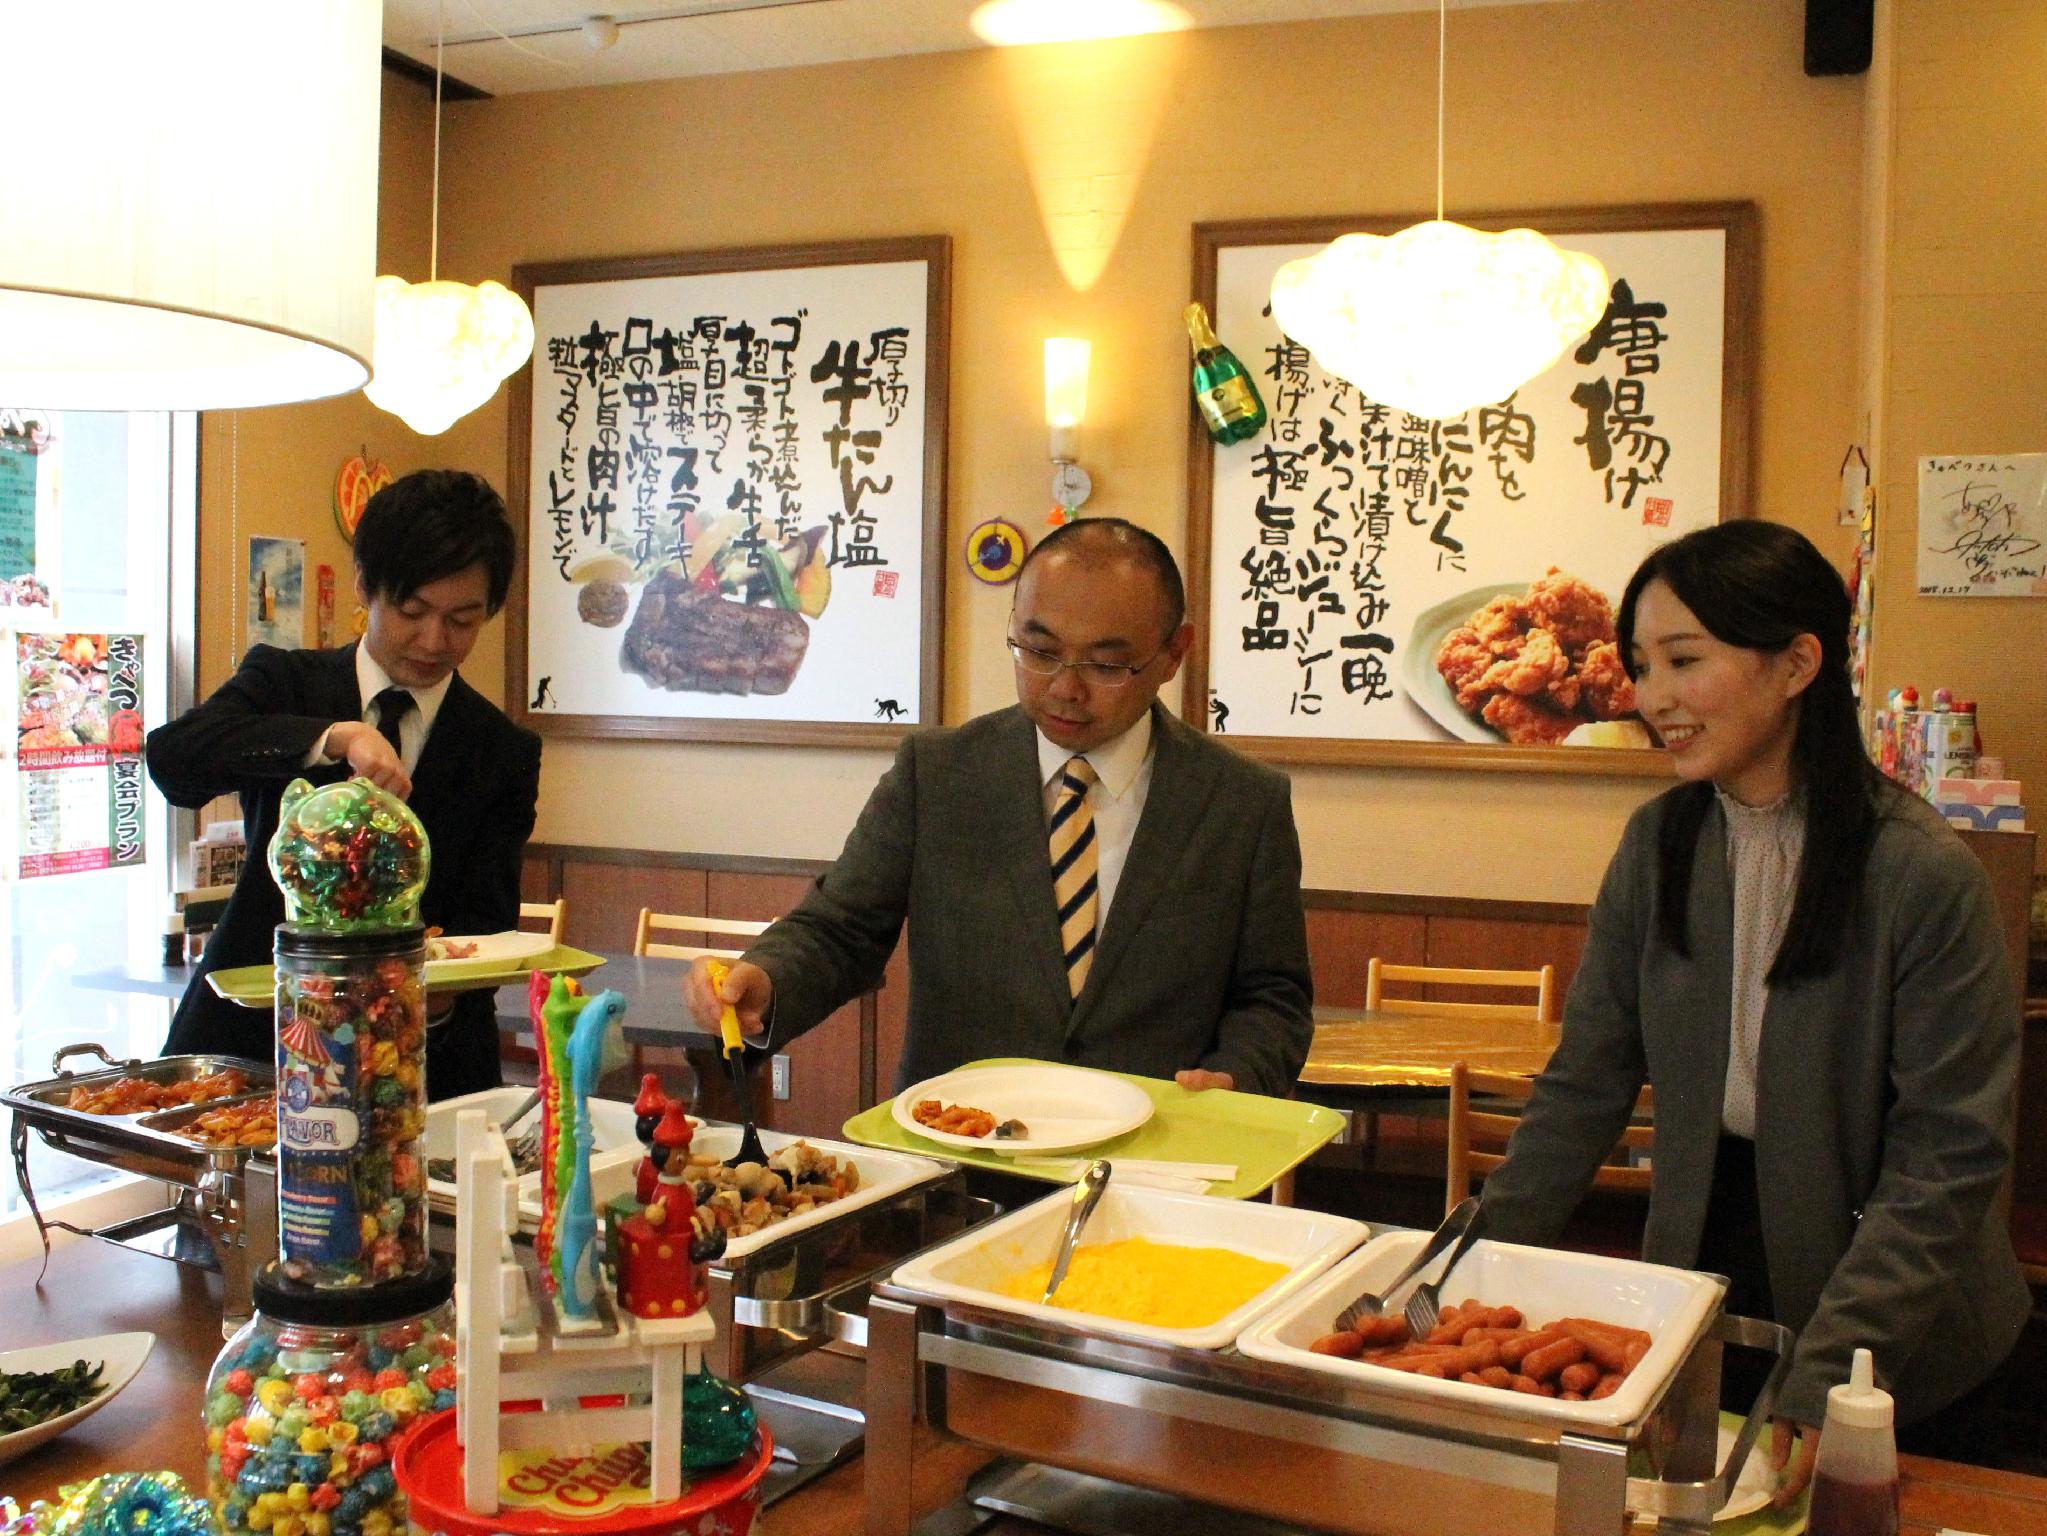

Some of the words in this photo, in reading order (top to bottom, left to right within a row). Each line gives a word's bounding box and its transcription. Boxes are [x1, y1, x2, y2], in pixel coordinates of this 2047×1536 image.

[622, 317, 662, 571] 口の中で溶けだす
[688, 316, 731, 473] 厚目に切って
[769, 308, 808, 540] ゴトゴト煮込んだ
[811, 340, 892, 568] 牛たん塩
[864, 327, 909, 426] 厚切り
[1570, 278, 1670, 509] 唐揚げ
[1429, 411, 1473, 572] にんにくに
[114, 760, 140, 860] 宴会プラン
